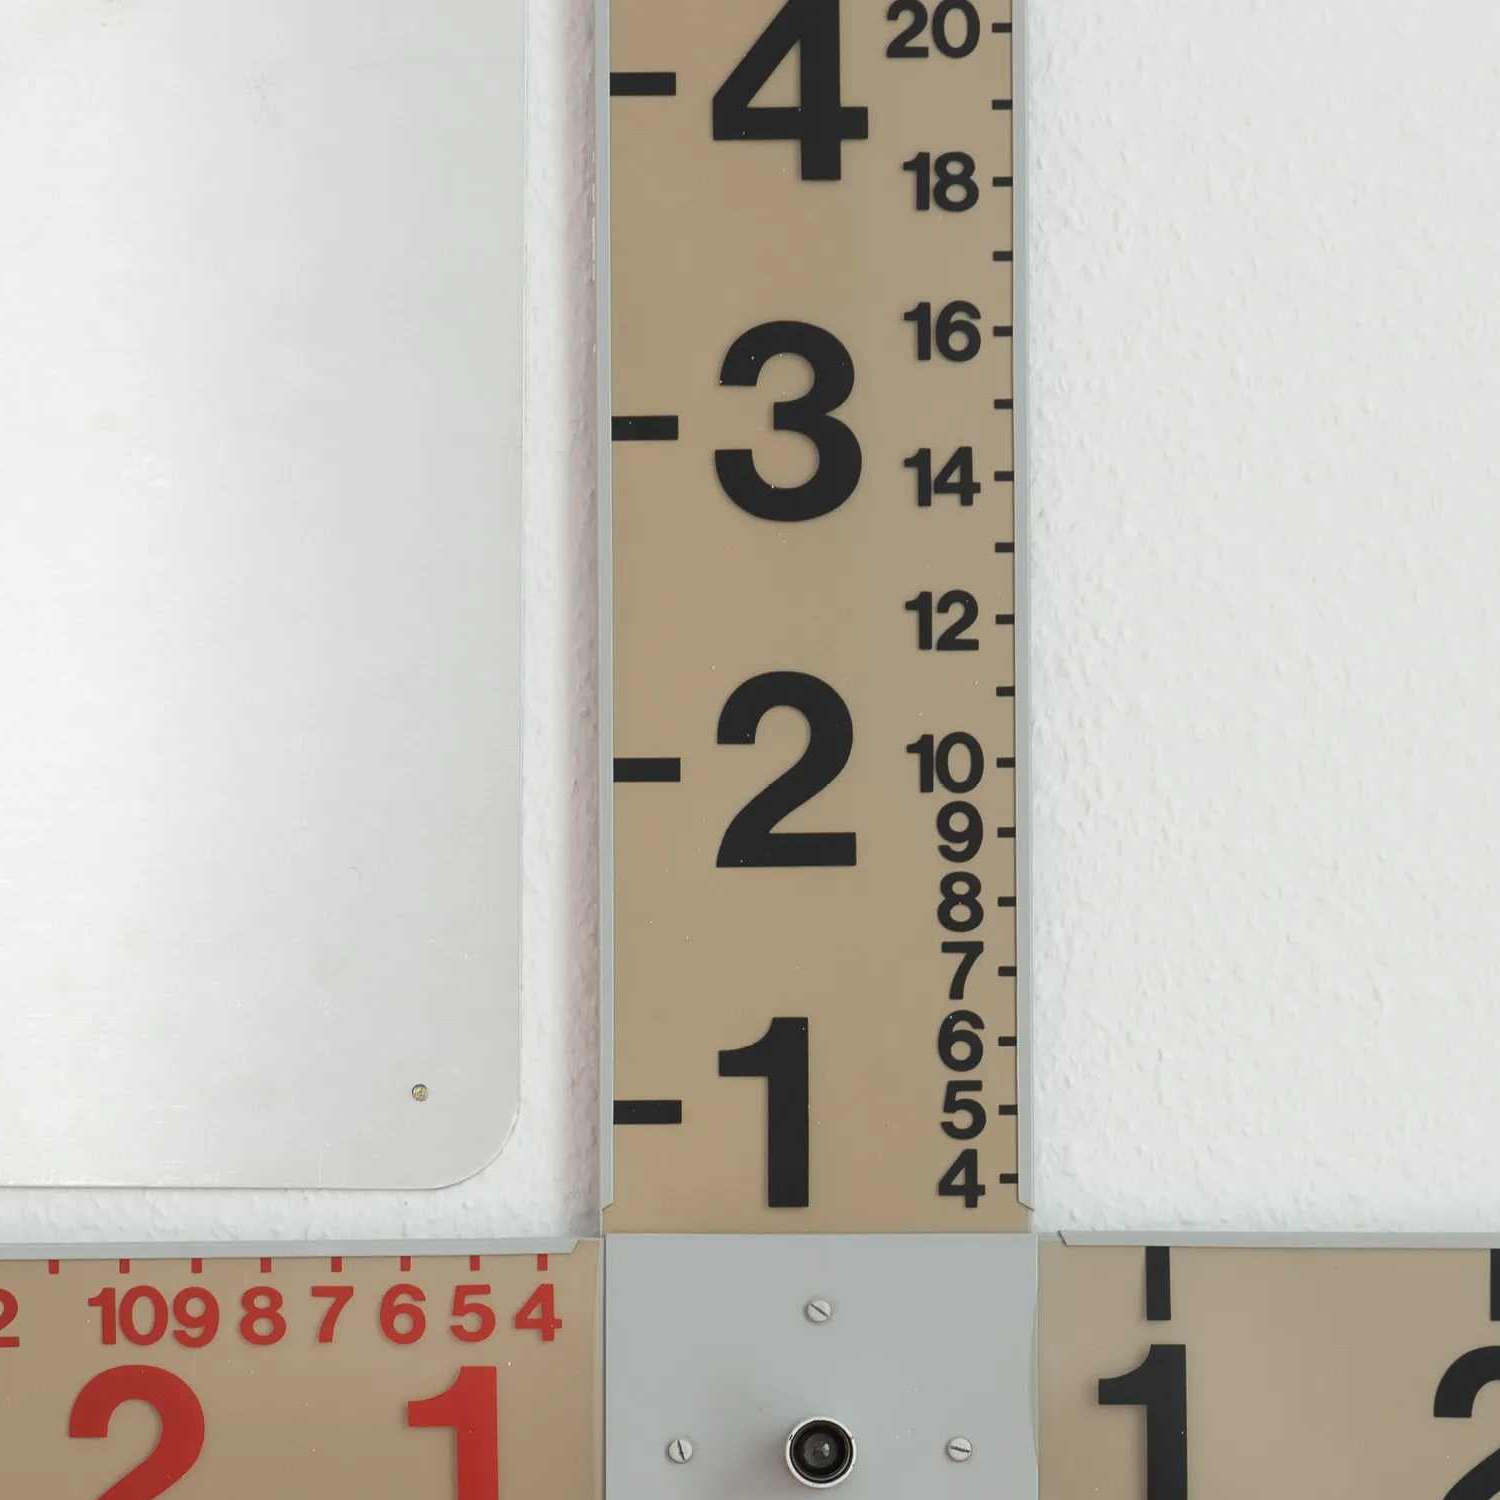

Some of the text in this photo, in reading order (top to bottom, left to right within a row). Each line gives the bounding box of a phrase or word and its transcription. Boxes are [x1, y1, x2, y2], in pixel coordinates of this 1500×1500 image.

[886, 0, 981, 59] 20
[711, 0, 869, 182] 4
[902, 151, 979, 213] 18
[903, 300, 982, 363] 16
[714, 320, 863, 523] 3
[903, 446, 981, 508] 14
[904, 589, 980, 652] 12
[715, 670, 857, 868] 2
[906, 731, 985, 794] 10
[936, 800, 984, 863] 9
[937, 871, 984, 933] 8
[941, 940, 984, 1001] 7
[937, 1009, 985, 1073] 6
[718, 1016, 810, 1209] 1
[940, 1079, 987, 1141] 5
[937, 1148, 986, 1209] 4
[87, 1285, 169, 1346] 10
[173, 1286, 220, 1348] 9
[240, 1286, 287, 1345] 8
[311, 1285, 354, 1343] 7
[379, 1283, 427, 1345] 6
[450, 1284, 496, 1343] 5
[514, 1283, 563, 1342] 4
